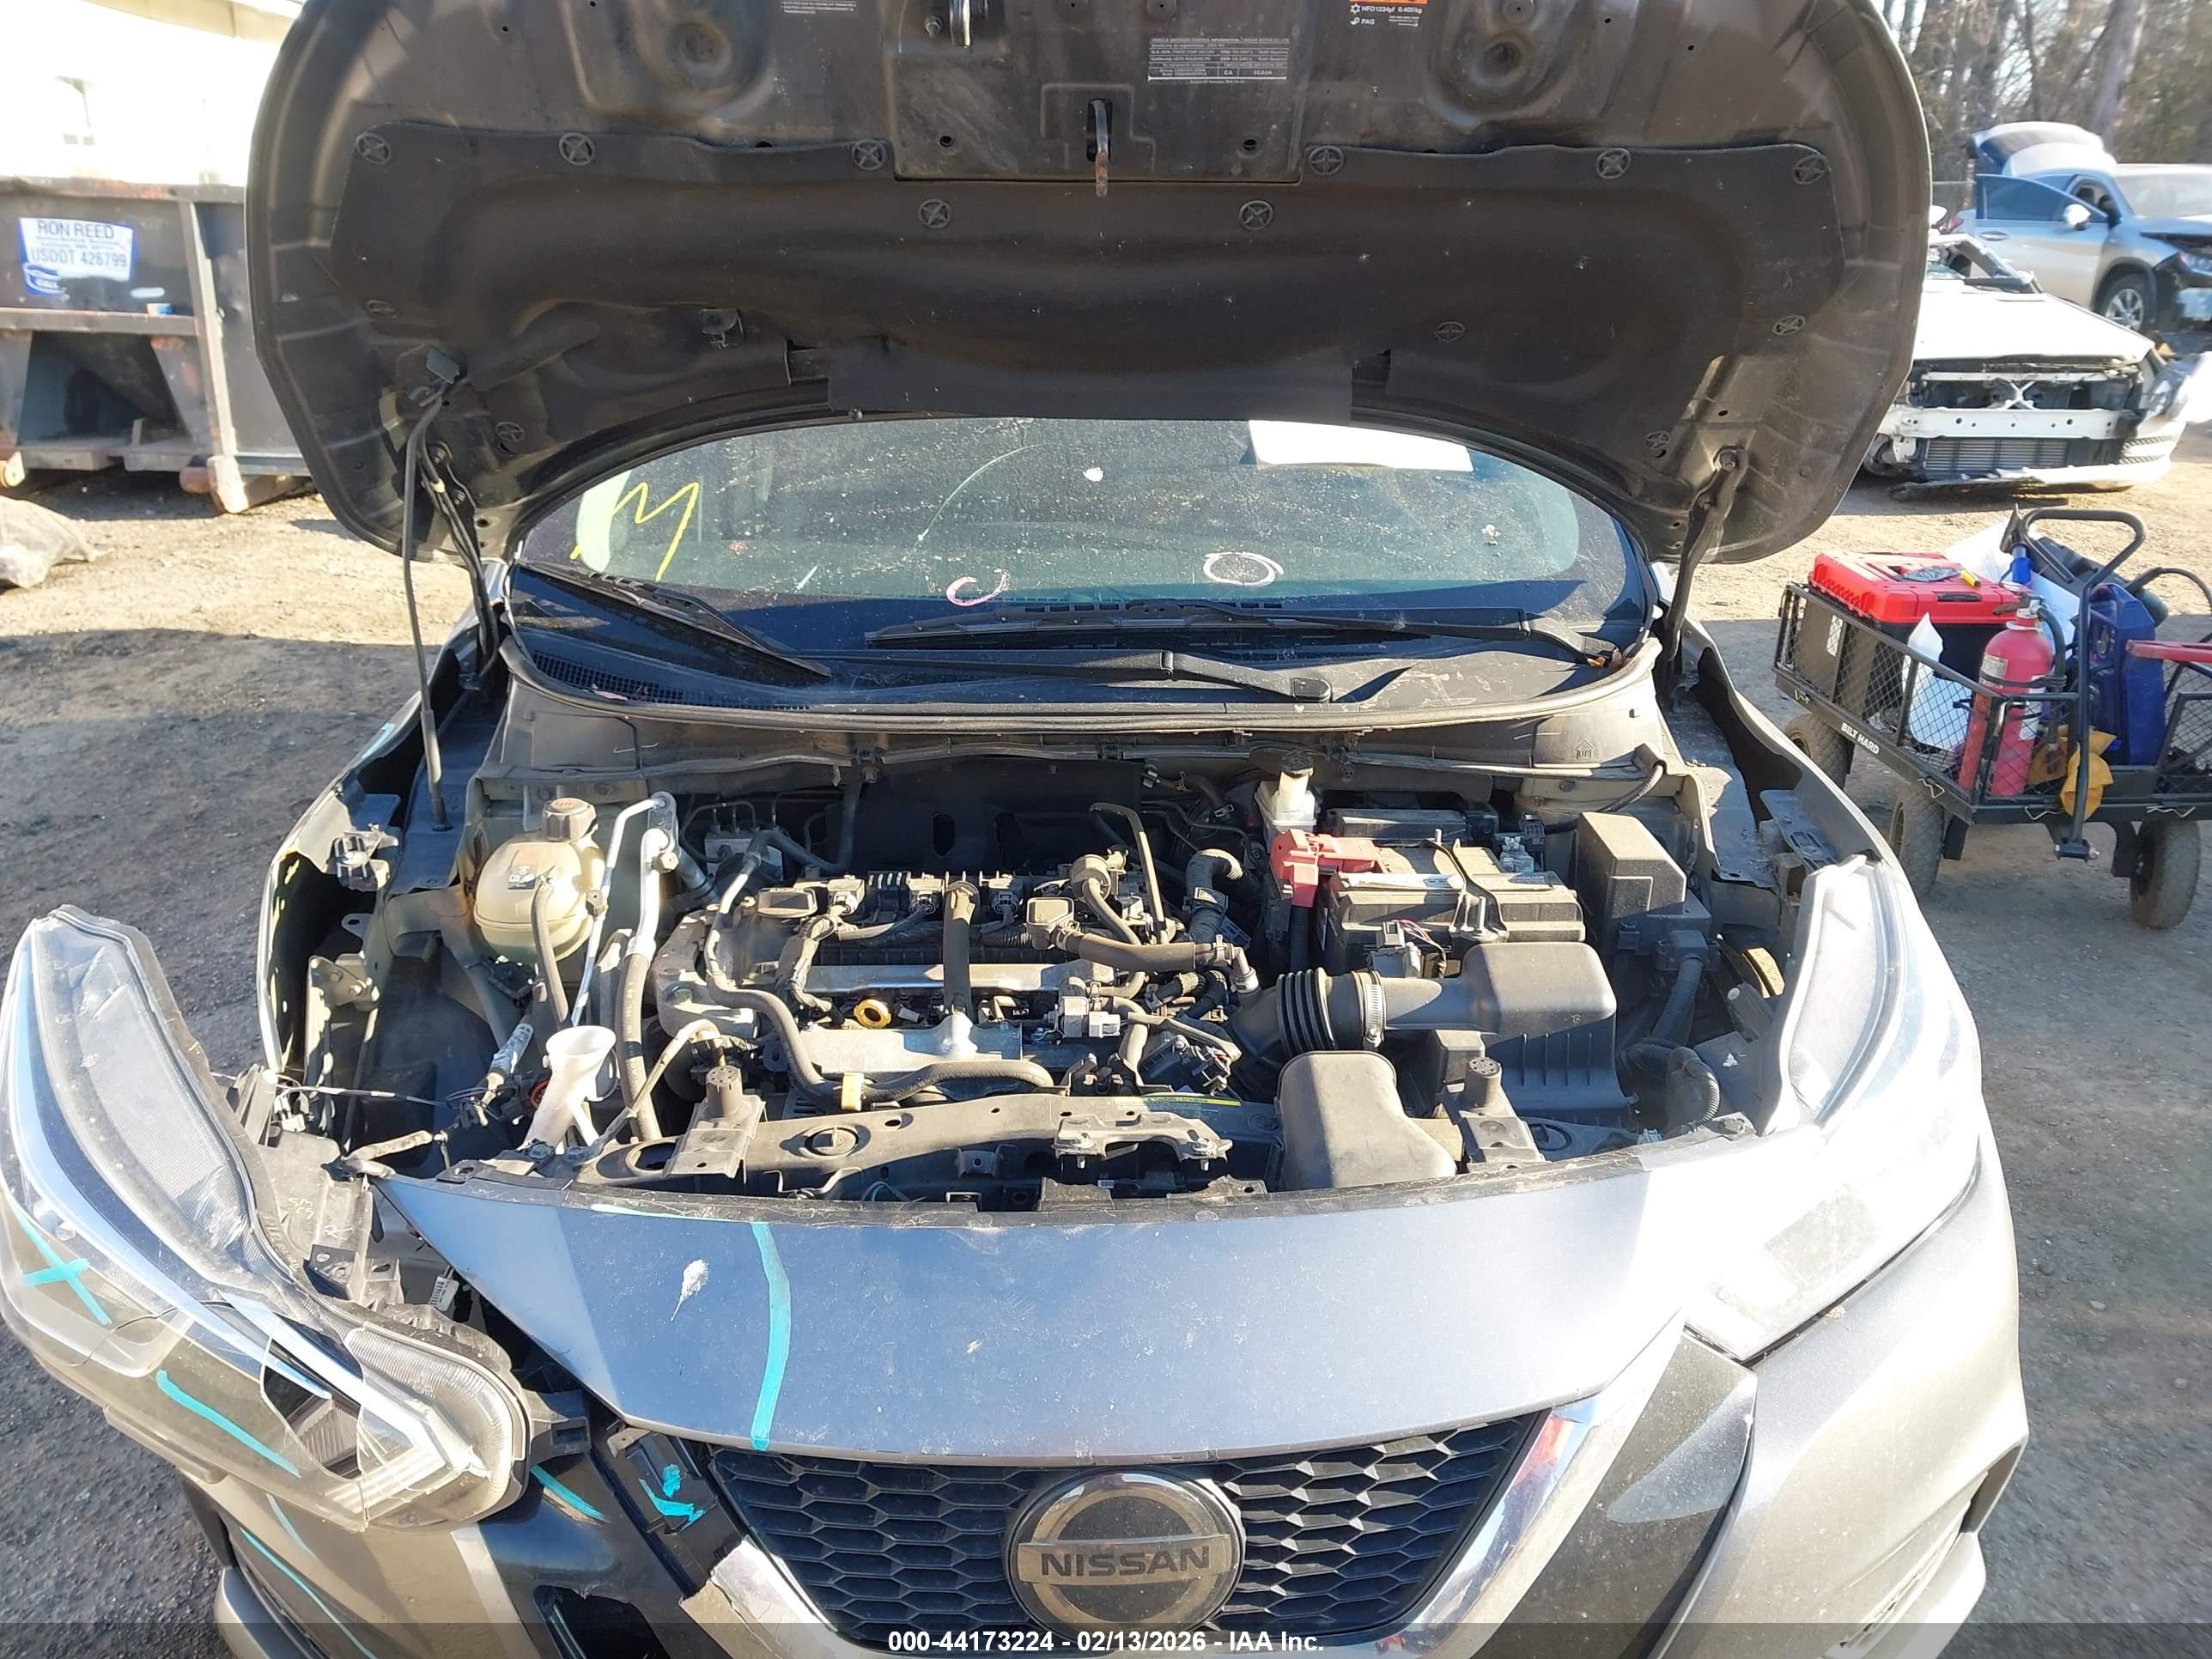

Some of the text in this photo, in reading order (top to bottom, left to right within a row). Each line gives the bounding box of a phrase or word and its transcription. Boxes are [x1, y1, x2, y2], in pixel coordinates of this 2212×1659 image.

[38, 221, 114, 239] RON REED
[32, 249, 127, 268] USDOT 426799
[1840, 721, 1881, 755] BILT HARD
[1040, 1545, 1211, 1578] NISSAN
